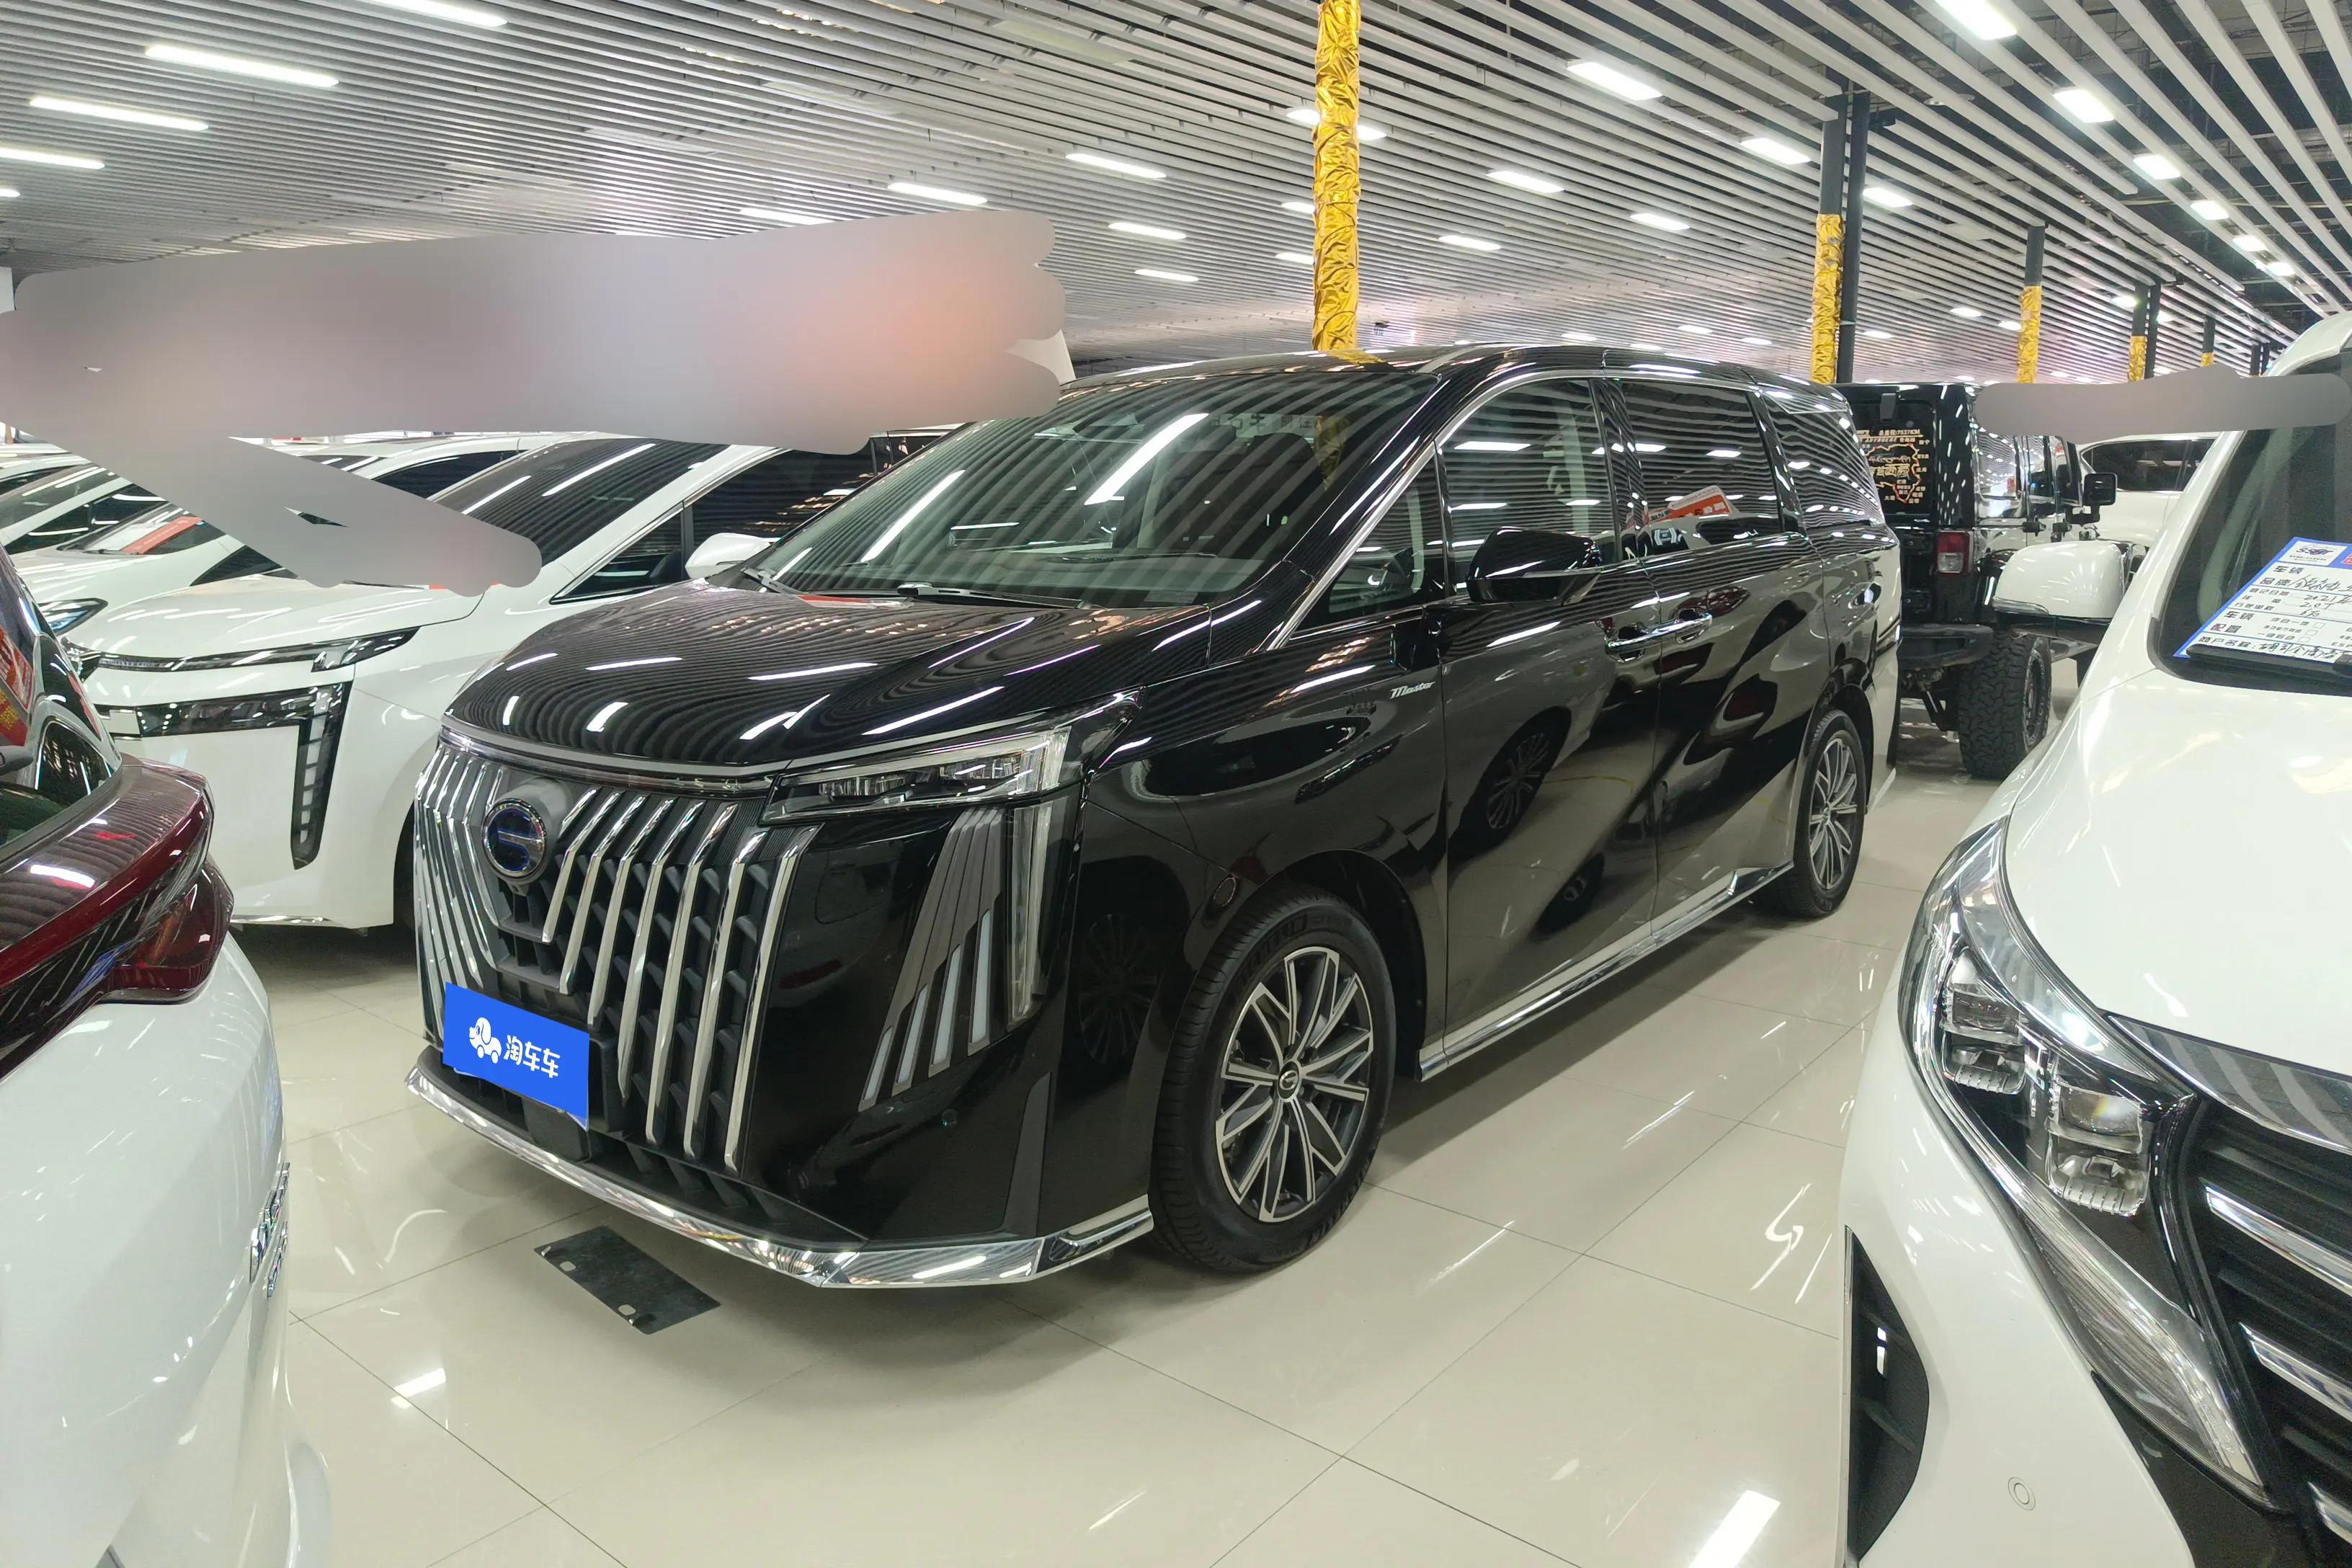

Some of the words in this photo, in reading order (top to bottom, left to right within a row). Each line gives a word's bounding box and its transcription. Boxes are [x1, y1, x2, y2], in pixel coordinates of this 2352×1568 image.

[2273, 565, 2305, 575] 车辆
[2260, 577, 2290, 587] 品牌
[2224, 610, 2253, 620] 车辆
[2210, 623, 2242, 633] 配置
[1389, 681, 1435, 699] Master
